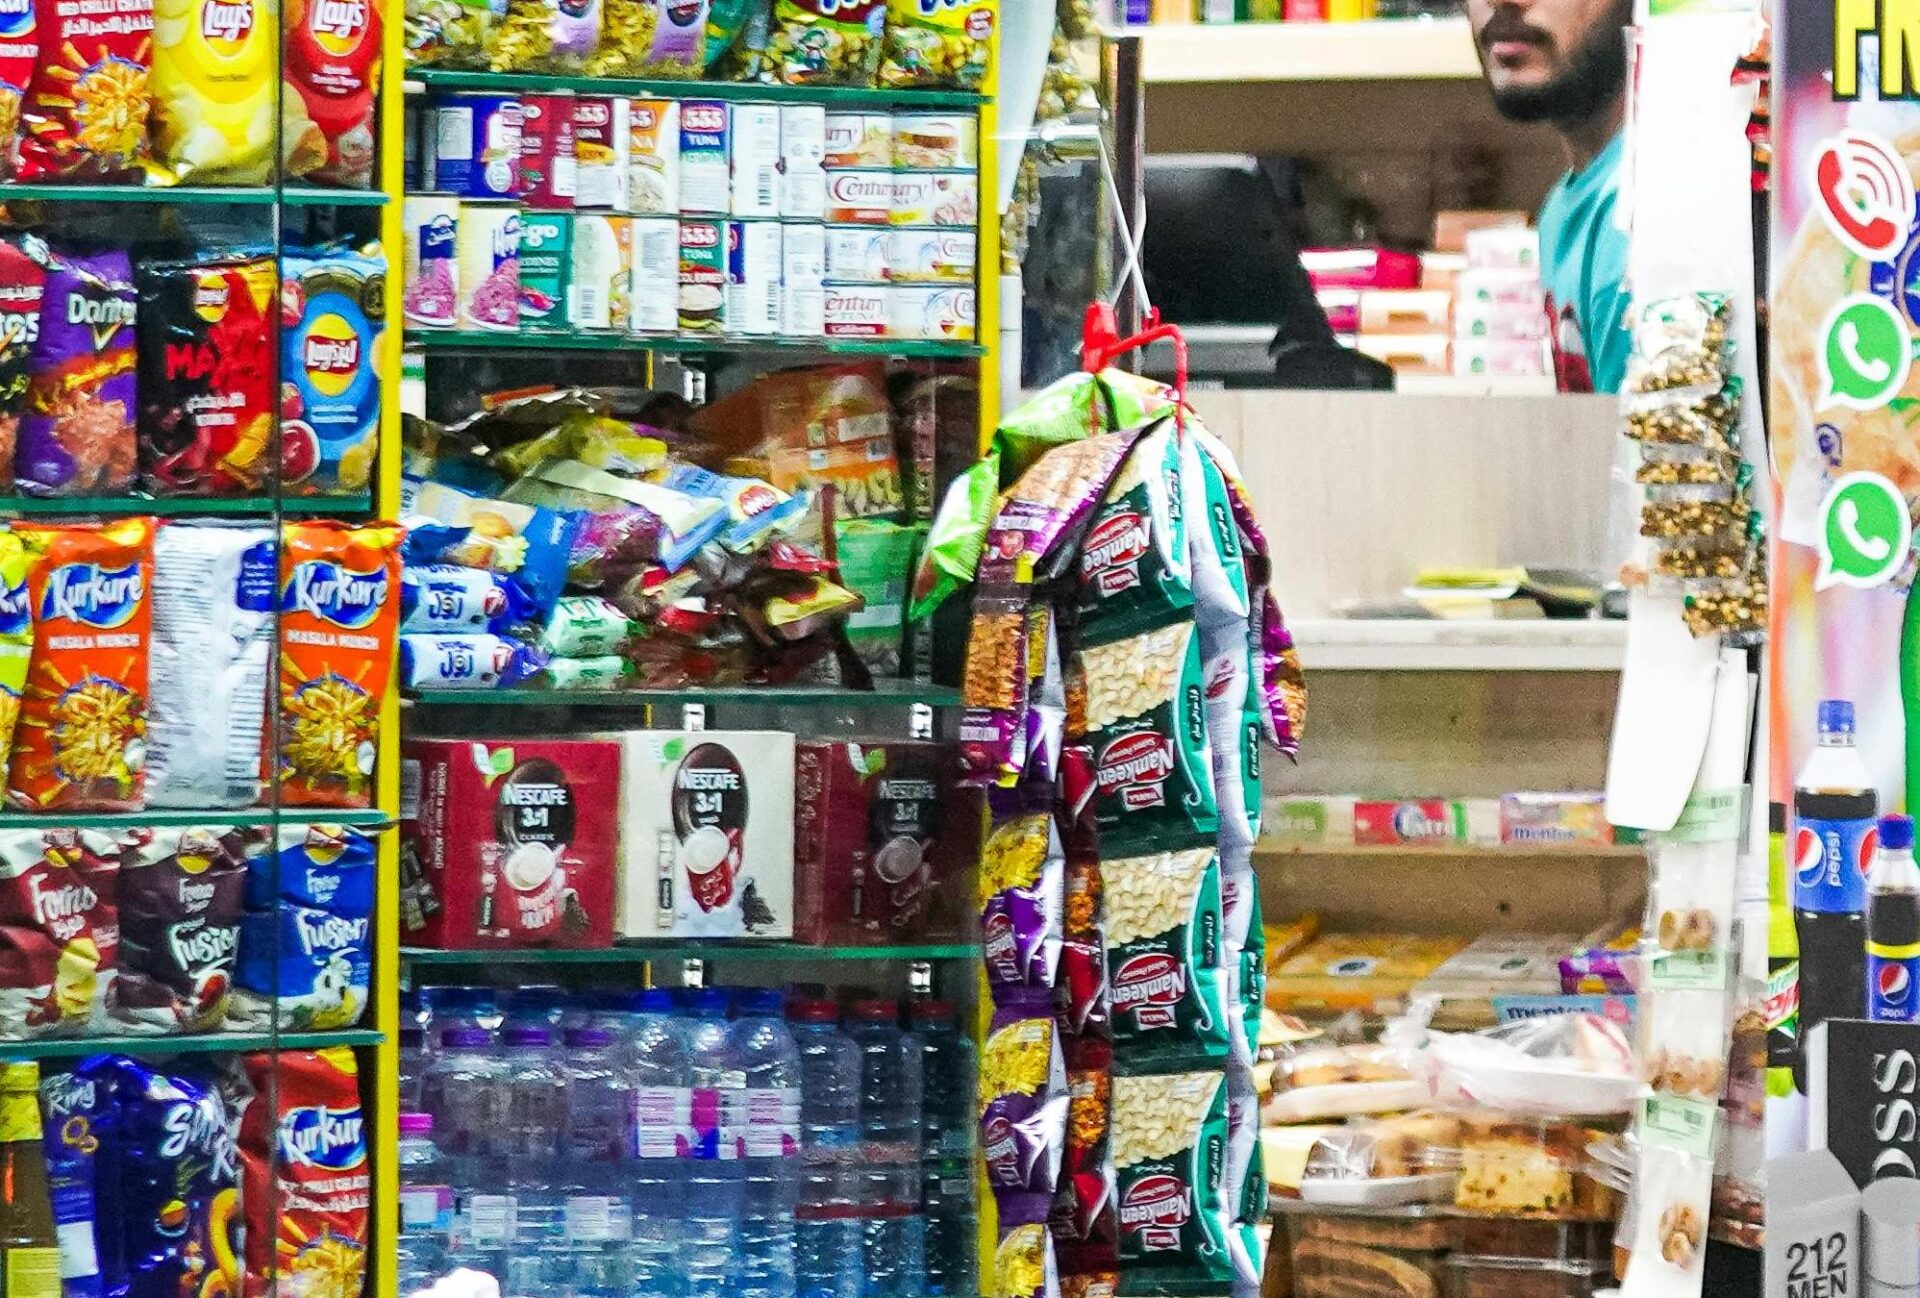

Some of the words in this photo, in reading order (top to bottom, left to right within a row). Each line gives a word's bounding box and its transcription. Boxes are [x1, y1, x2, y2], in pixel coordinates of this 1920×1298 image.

[684, 109, 723, 128] 555
[681, 227, 717, 244] 555
[1083, 516, 1152, 574] Namkee
[50, 564, 143, 623] Kurkure
[294, 564, 387, 619] Kurkure
[1096, 739, 1174, 786] Namkeen
[1826, 831, 1843, 888] pepsi
[1108, 963, 1186, 1004] Namkeen
[276, 1105, 363, 1168] Kurkur
[1121, 1186, 1192, 1224] Namkeen
[1787, 1232, 1847, 1282] 212
[1787, 1270, 1847, 1298] MEN
